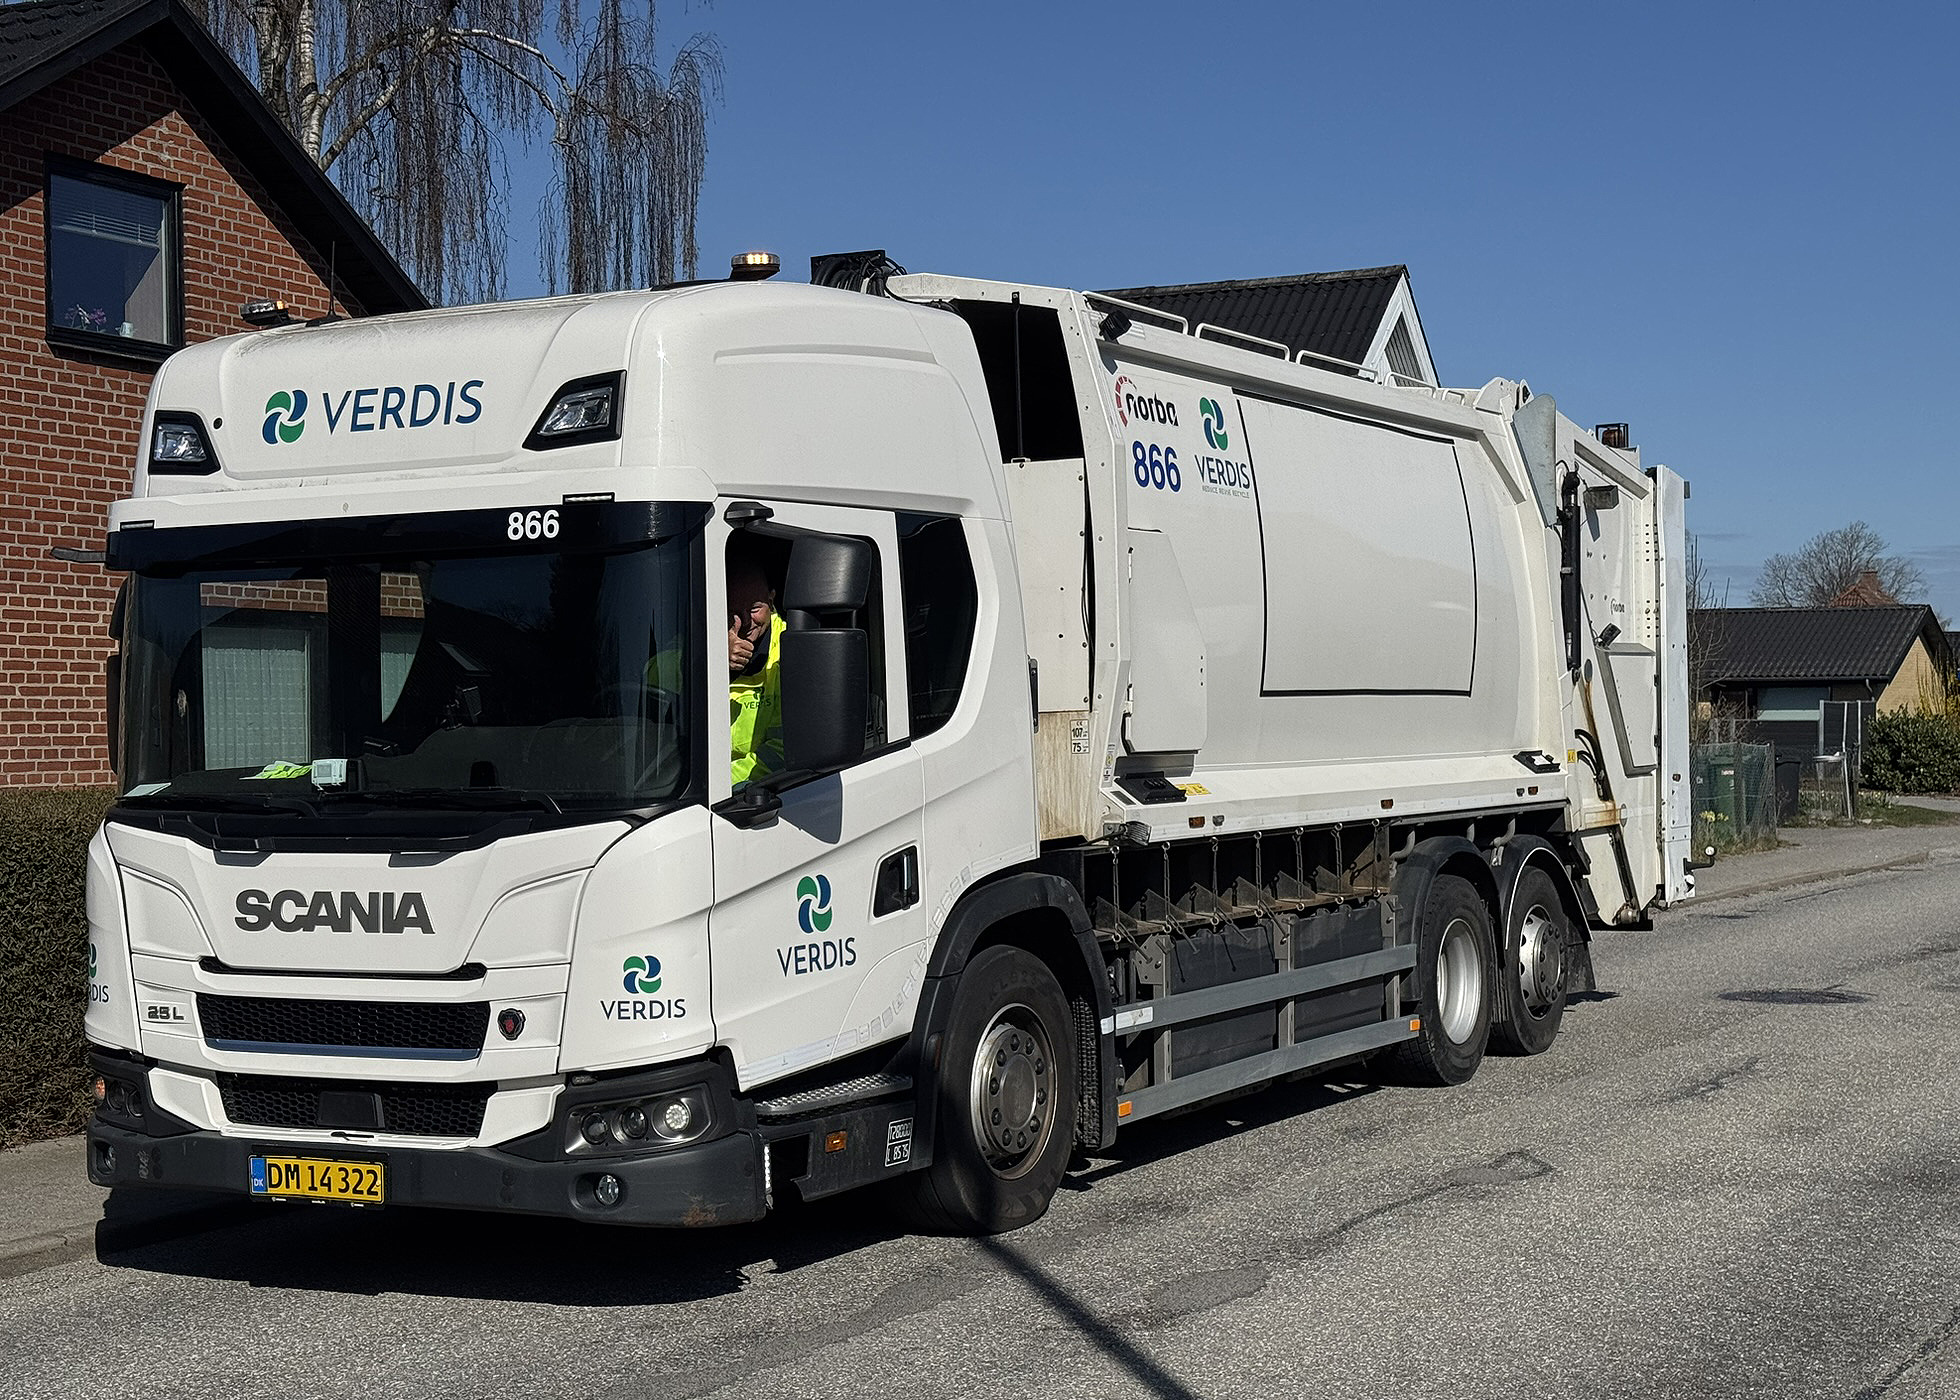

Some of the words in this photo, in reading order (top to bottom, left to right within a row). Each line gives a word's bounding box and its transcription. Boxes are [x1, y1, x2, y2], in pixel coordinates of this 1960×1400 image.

[322, 379, 484, 436] VERDIS
[1125, 393, 1179, 427] norba
[1132, 440, 1181, 492] 866
[1194, 454, 1250, 489] VERDIS
[507, 509, 560, 541] 866
[1071, 727, 1083, 738] 107
[1072, 742, 1082, 752] 75
[234, 888, 436, 934] SCANIA
[776, 937, 857, 977] VERDIS
[147, 1005, 171, 1019] 25
[173, 1006, 185, 1021] L
[600, 999, 686, 1020] VERDIS
[253, 1178, 264, 1187] DK
[267, 1163, 301, 1190] DM
[307, 1165, 332, 1193] 14
[337, 1166, 379, 1197] 322
